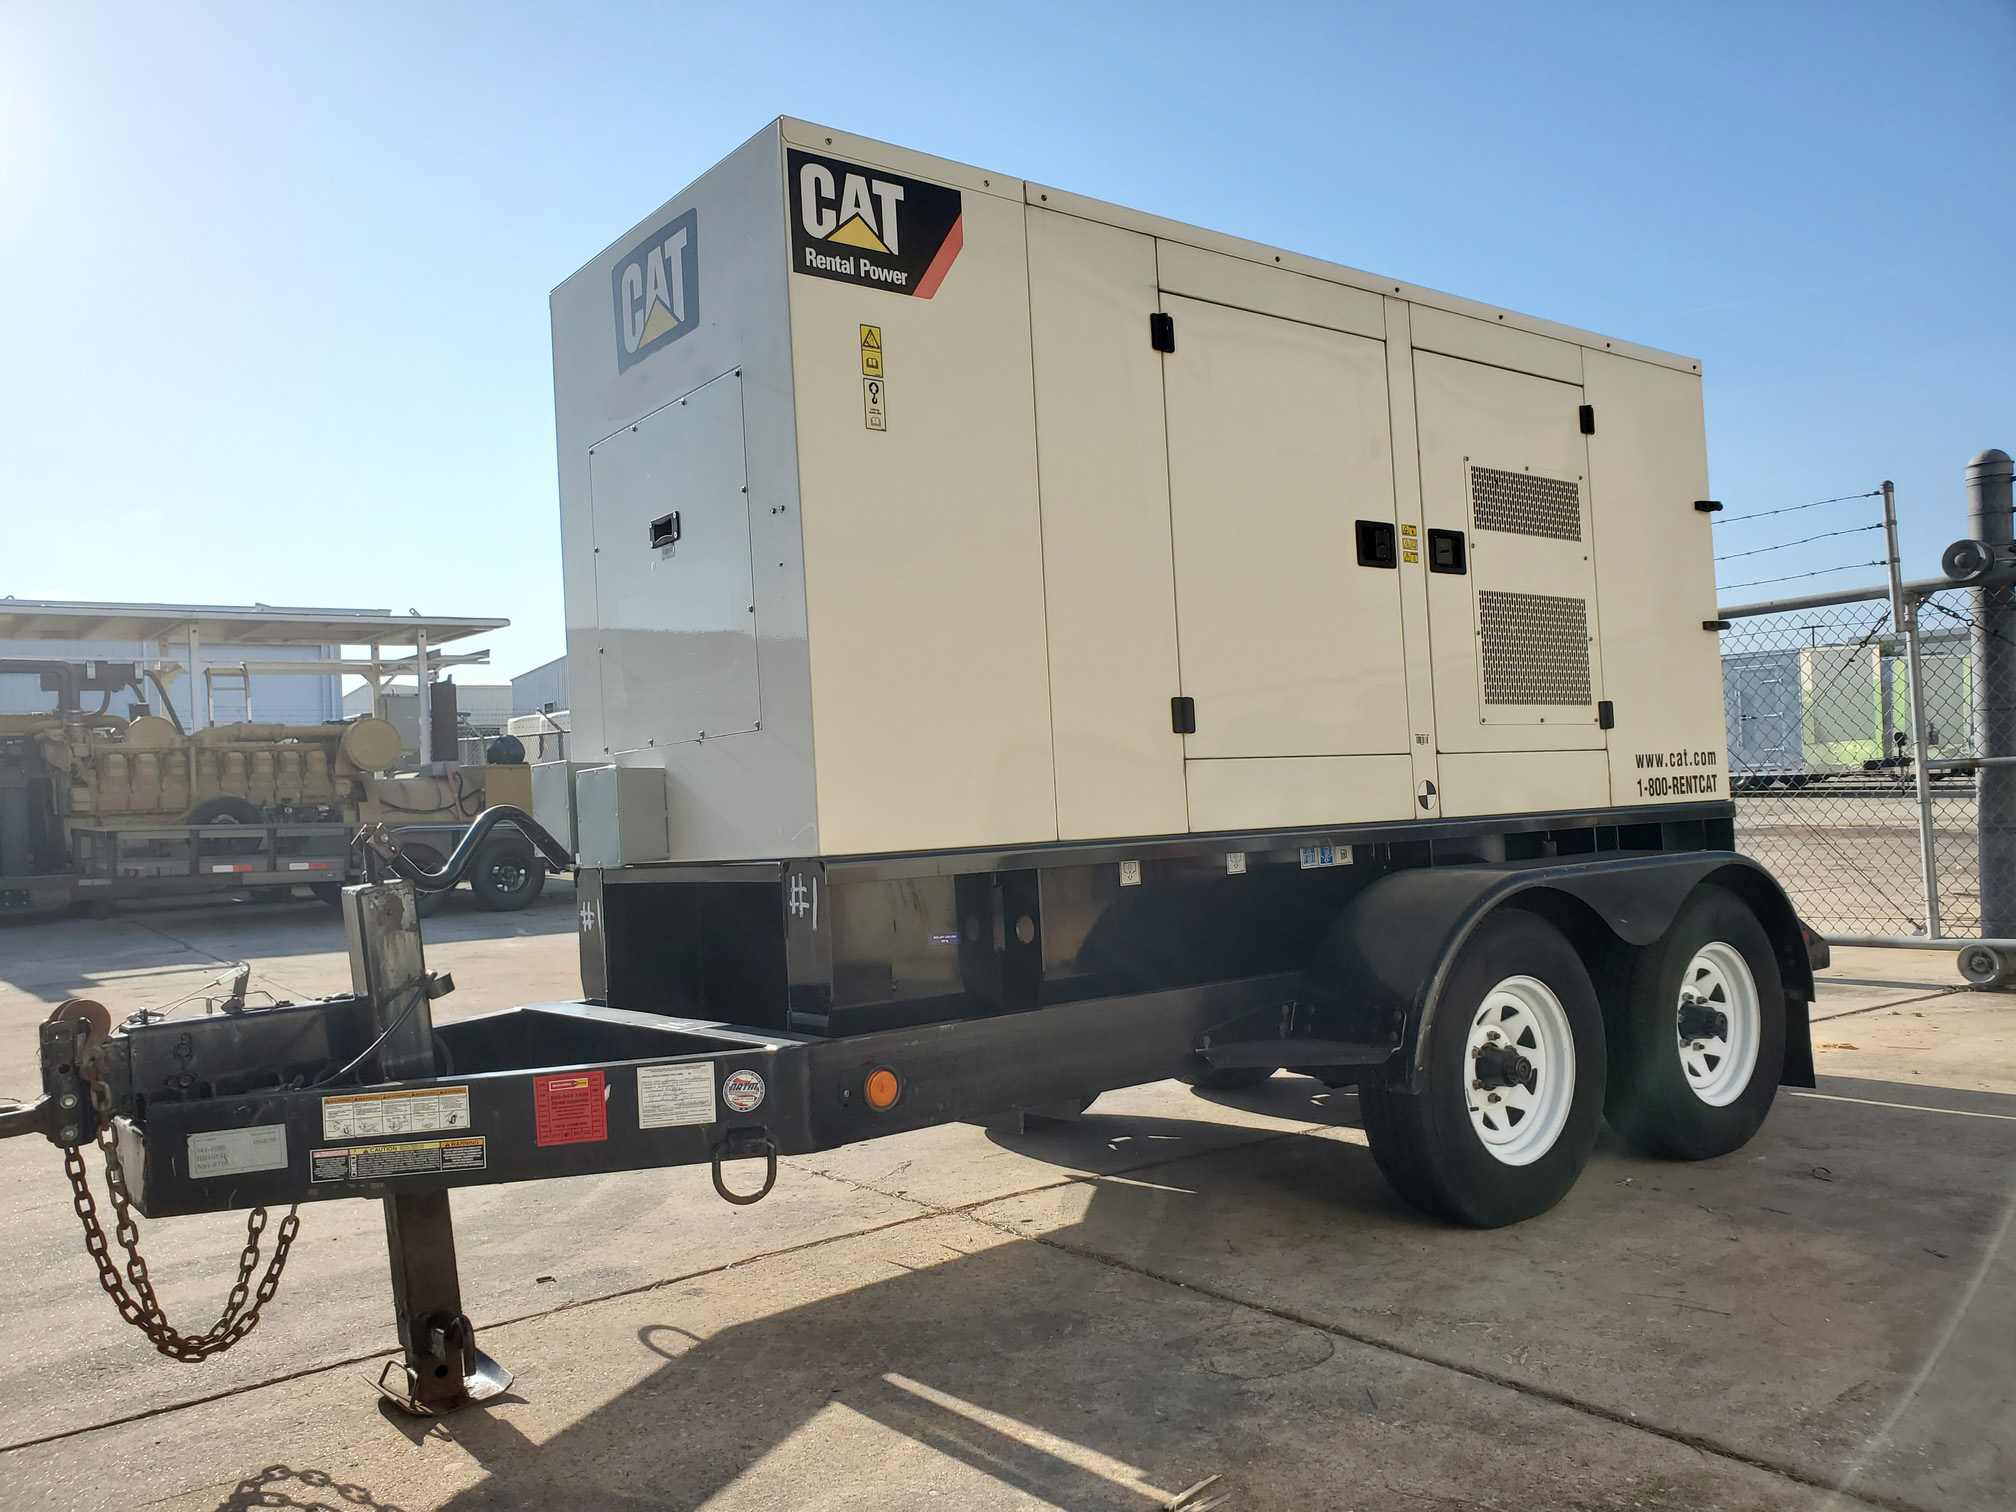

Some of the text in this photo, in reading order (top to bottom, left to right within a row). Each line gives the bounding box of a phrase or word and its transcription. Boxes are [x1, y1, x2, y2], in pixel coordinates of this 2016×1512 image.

[800, 162, 905, 256] CAT
[805, 247, 908, 286] Rental Power
[621, 226, 688, 354] CAT
[1635, 748, 1717, 769] www.cat.com
[1637, 774, 1717, 797] 1-800-RENTCAT
